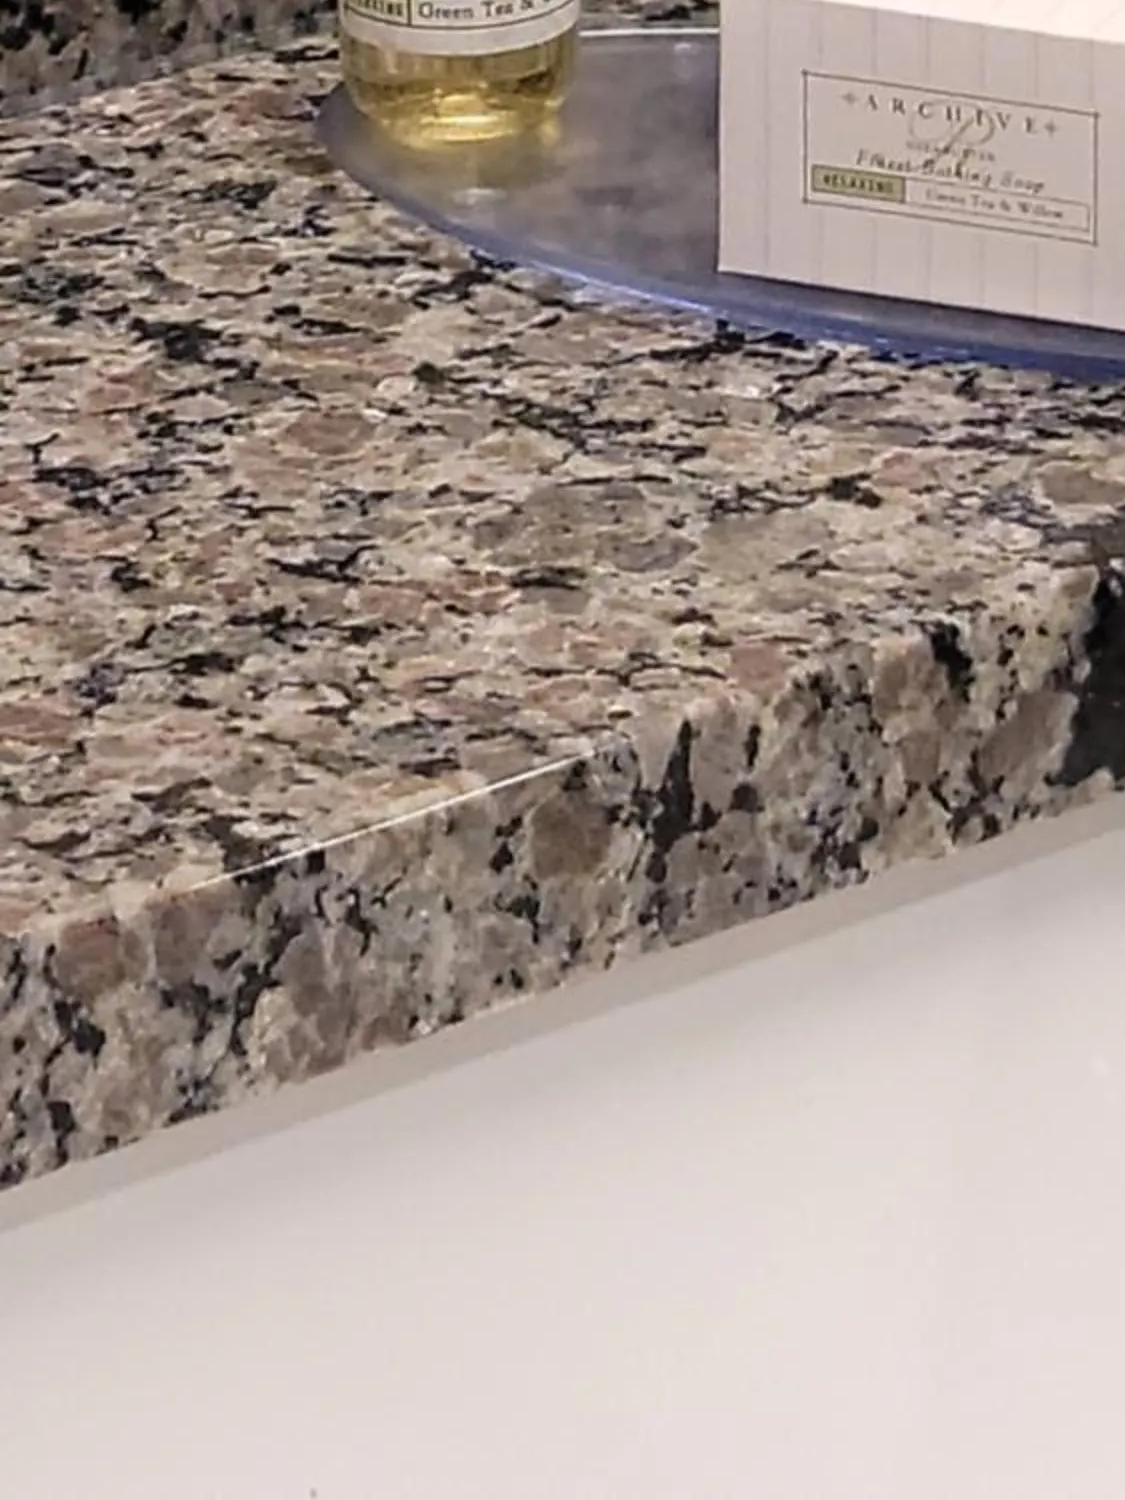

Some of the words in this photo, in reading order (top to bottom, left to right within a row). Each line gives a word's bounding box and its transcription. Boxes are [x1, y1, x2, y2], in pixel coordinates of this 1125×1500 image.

[418, 1, 475, 21] Green
[480, 0, 514, 18] Tea
[867, 94, 1038, 134] ARCHIVE
